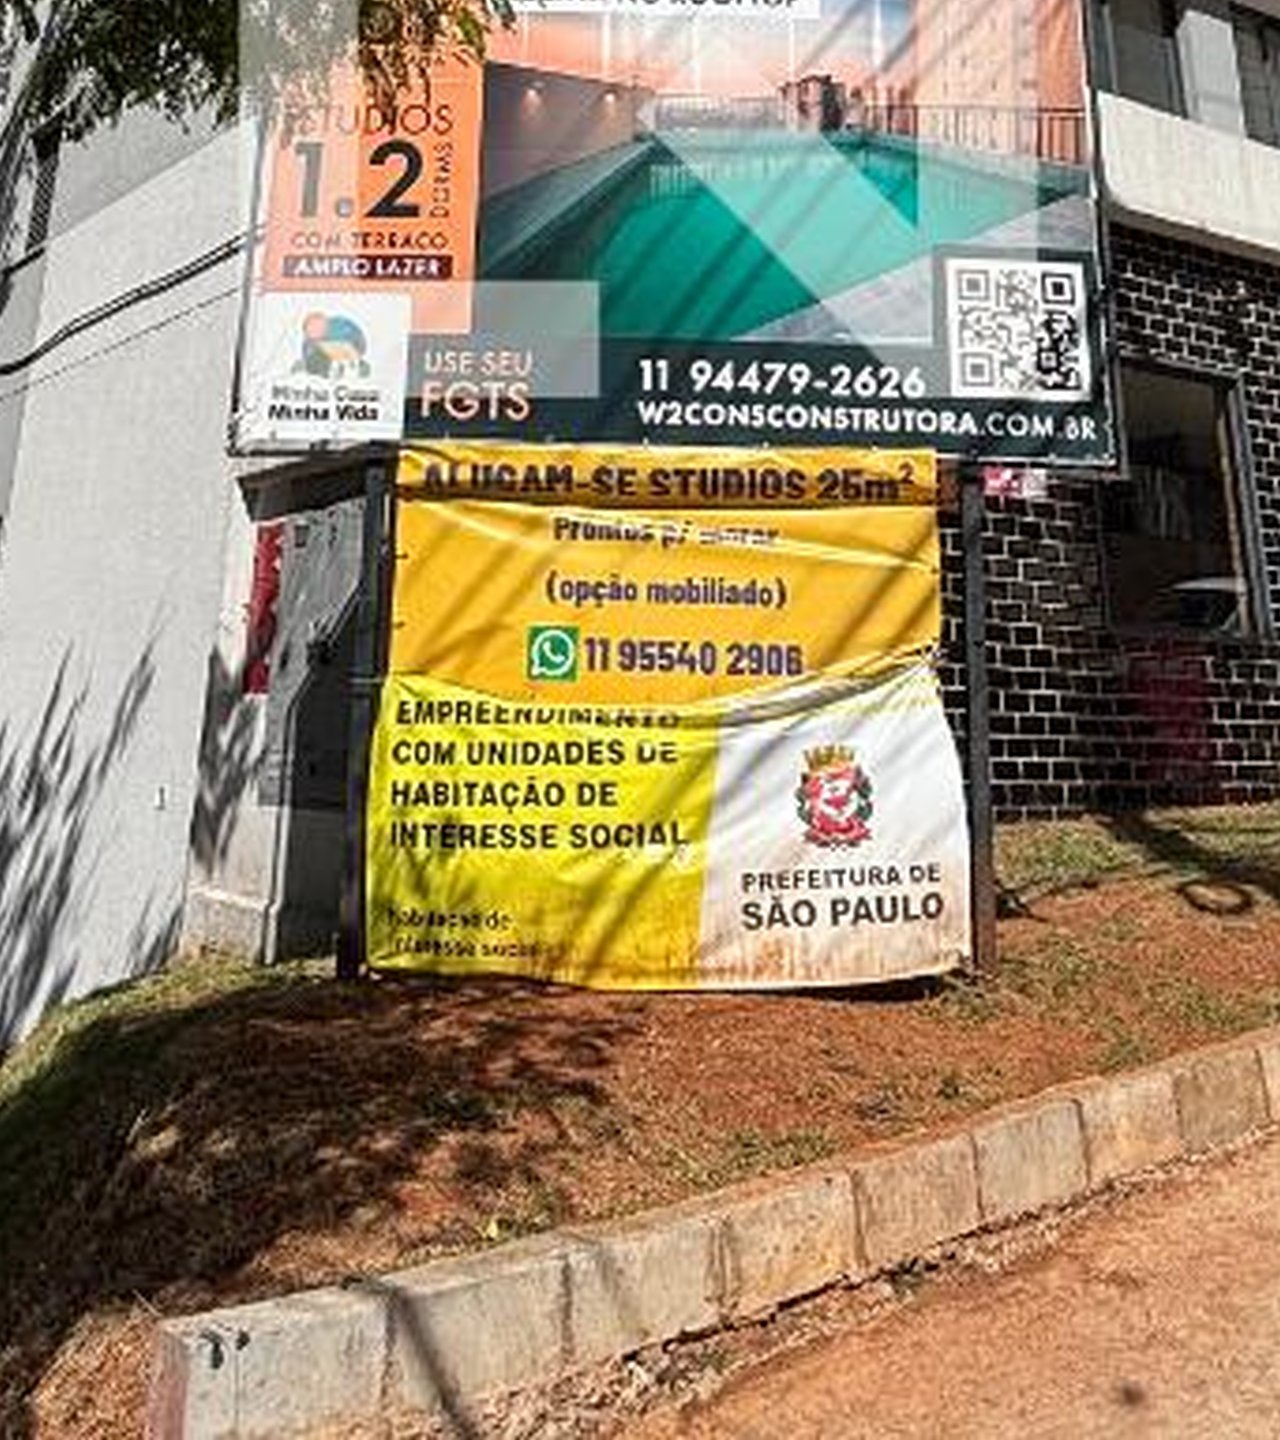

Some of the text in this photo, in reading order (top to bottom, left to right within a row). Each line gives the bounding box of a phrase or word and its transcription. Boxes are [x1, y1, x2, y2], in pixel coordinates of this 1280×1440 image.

[365, 139, 423, 218] 2
[424, 350, 533, 378] USE SEU
[638, 359, 926, 399] 11 94479-2626
[270, 403, 379, 421] Minha Vida
[420, 380, 531, 421] FGTS
[649, 465, 807, 501] STUDIOS
[546, 569, 788, 610] (opção mobiliado)
[584, 636, 610, 672] 11
[618, 637, 717, 676] 95540
[391, 738, 679, 767] COM UNIDADES DE
[390, 775, 619, 815] HABITAÇÃO DE
[390, 820, 692, 850] INTERESSE SOCIAL
[741, 862, 942, 893] PREFEITURA DE
[741, 891, 945, 931] SÃO PAULO
